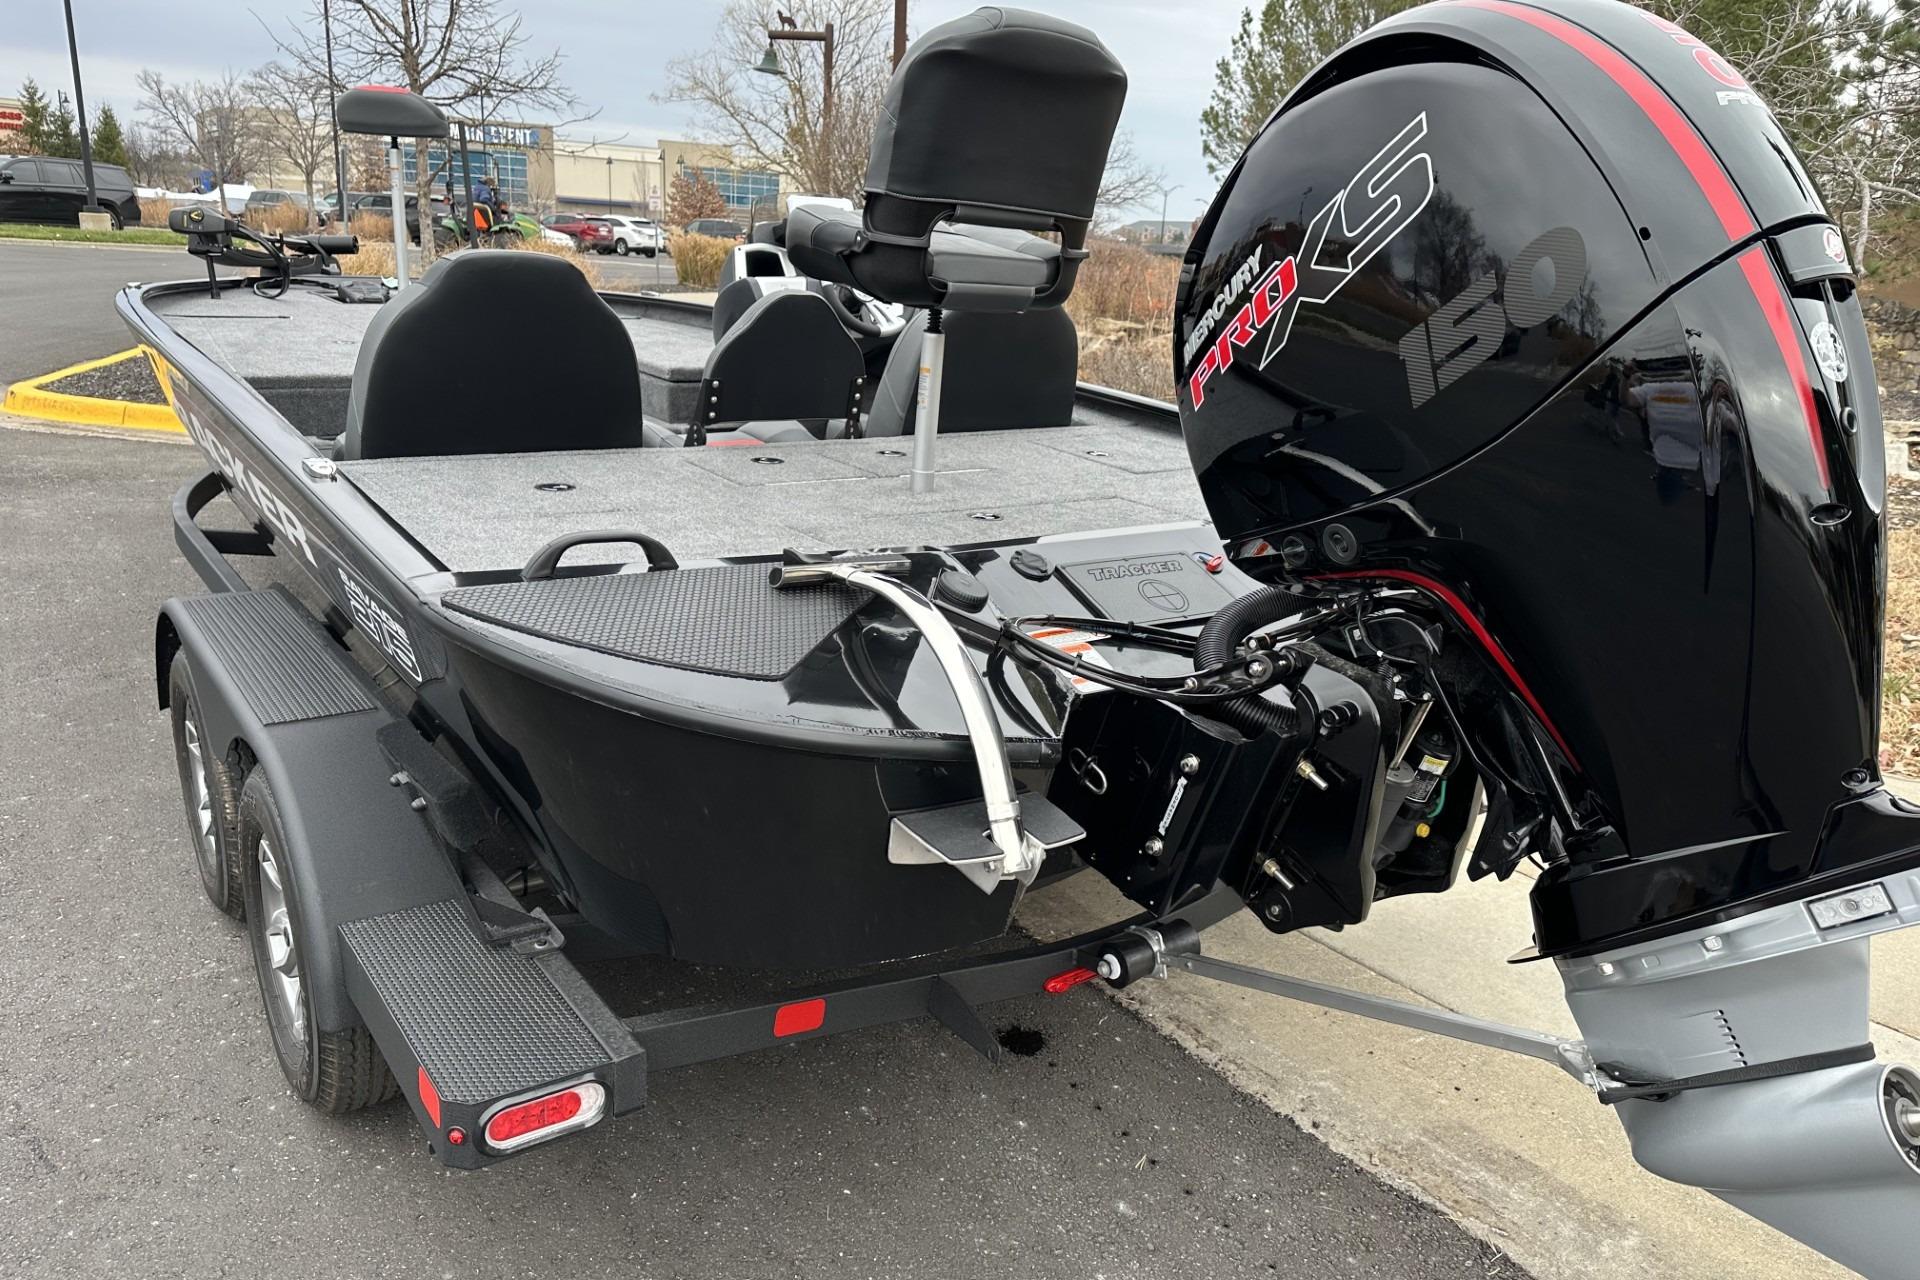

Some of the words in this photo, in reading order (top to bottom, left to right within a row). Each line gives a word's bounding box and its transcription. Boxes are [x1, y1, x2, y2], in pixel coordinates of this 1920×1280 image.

[490, 126, 532, 145] EVENT
[1183, 243, 1263, 367] MERCURY
[1189, 255, 1298, 412] PRO
[1249, 111, 1435, 371] XS
[1400, 226, 1587, 409] 150
[172, 399, 318, 568] RACKER
[1088, 560, 1183, 581] TRACKER
